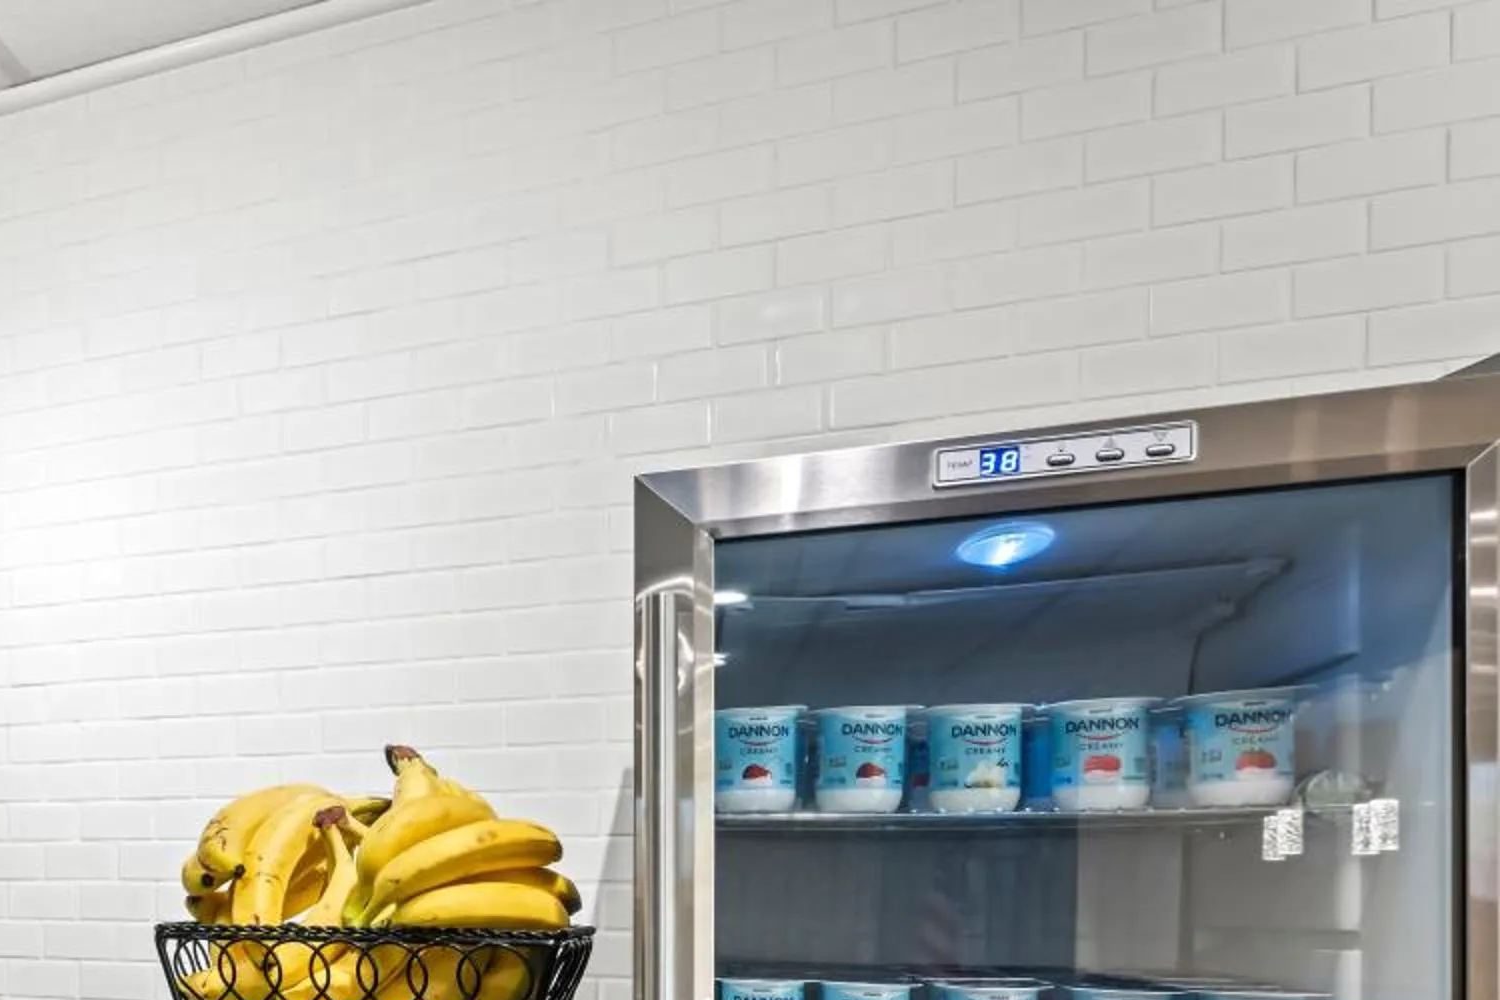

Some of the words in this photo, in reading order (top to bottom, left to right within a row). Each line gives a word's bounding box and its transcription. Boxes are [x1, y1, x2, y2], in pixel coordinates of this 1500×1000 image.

[981, 451, 1017, 474] 38
[1065, 717, 1139, 734] DANNON
[1215, 709, 1293, 728] DANNON
[728, 724, 789, 738] DANNON
[841, 723, 903, 735] DANNON
[951, 723, 1017, 738] DANNON
